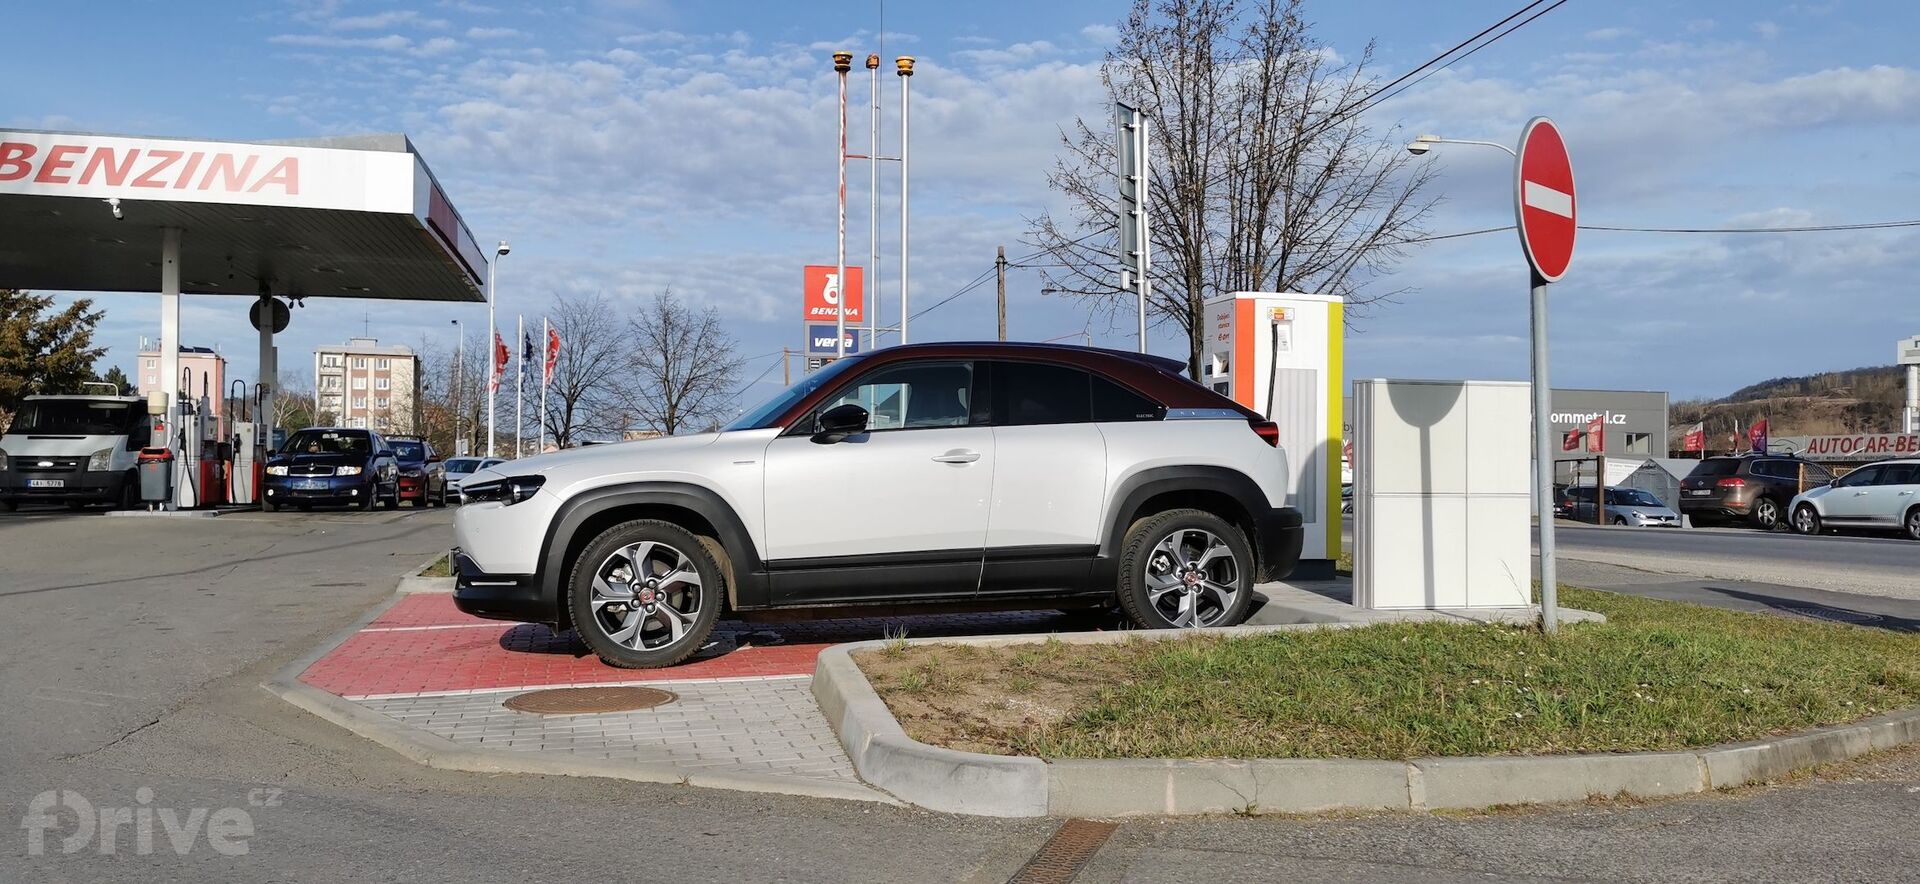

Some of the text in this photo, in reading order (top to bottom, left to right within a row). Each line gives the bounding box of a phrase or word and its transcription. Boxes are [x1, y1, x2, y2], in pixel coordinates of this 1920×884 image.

[0, 142, 300, 195] BENZINA
[811, 307, 858, 316] BENZNA
[814, 337, 853, 347] vera
[1807, 436, 1920, 454] AUTOCAR-BE
